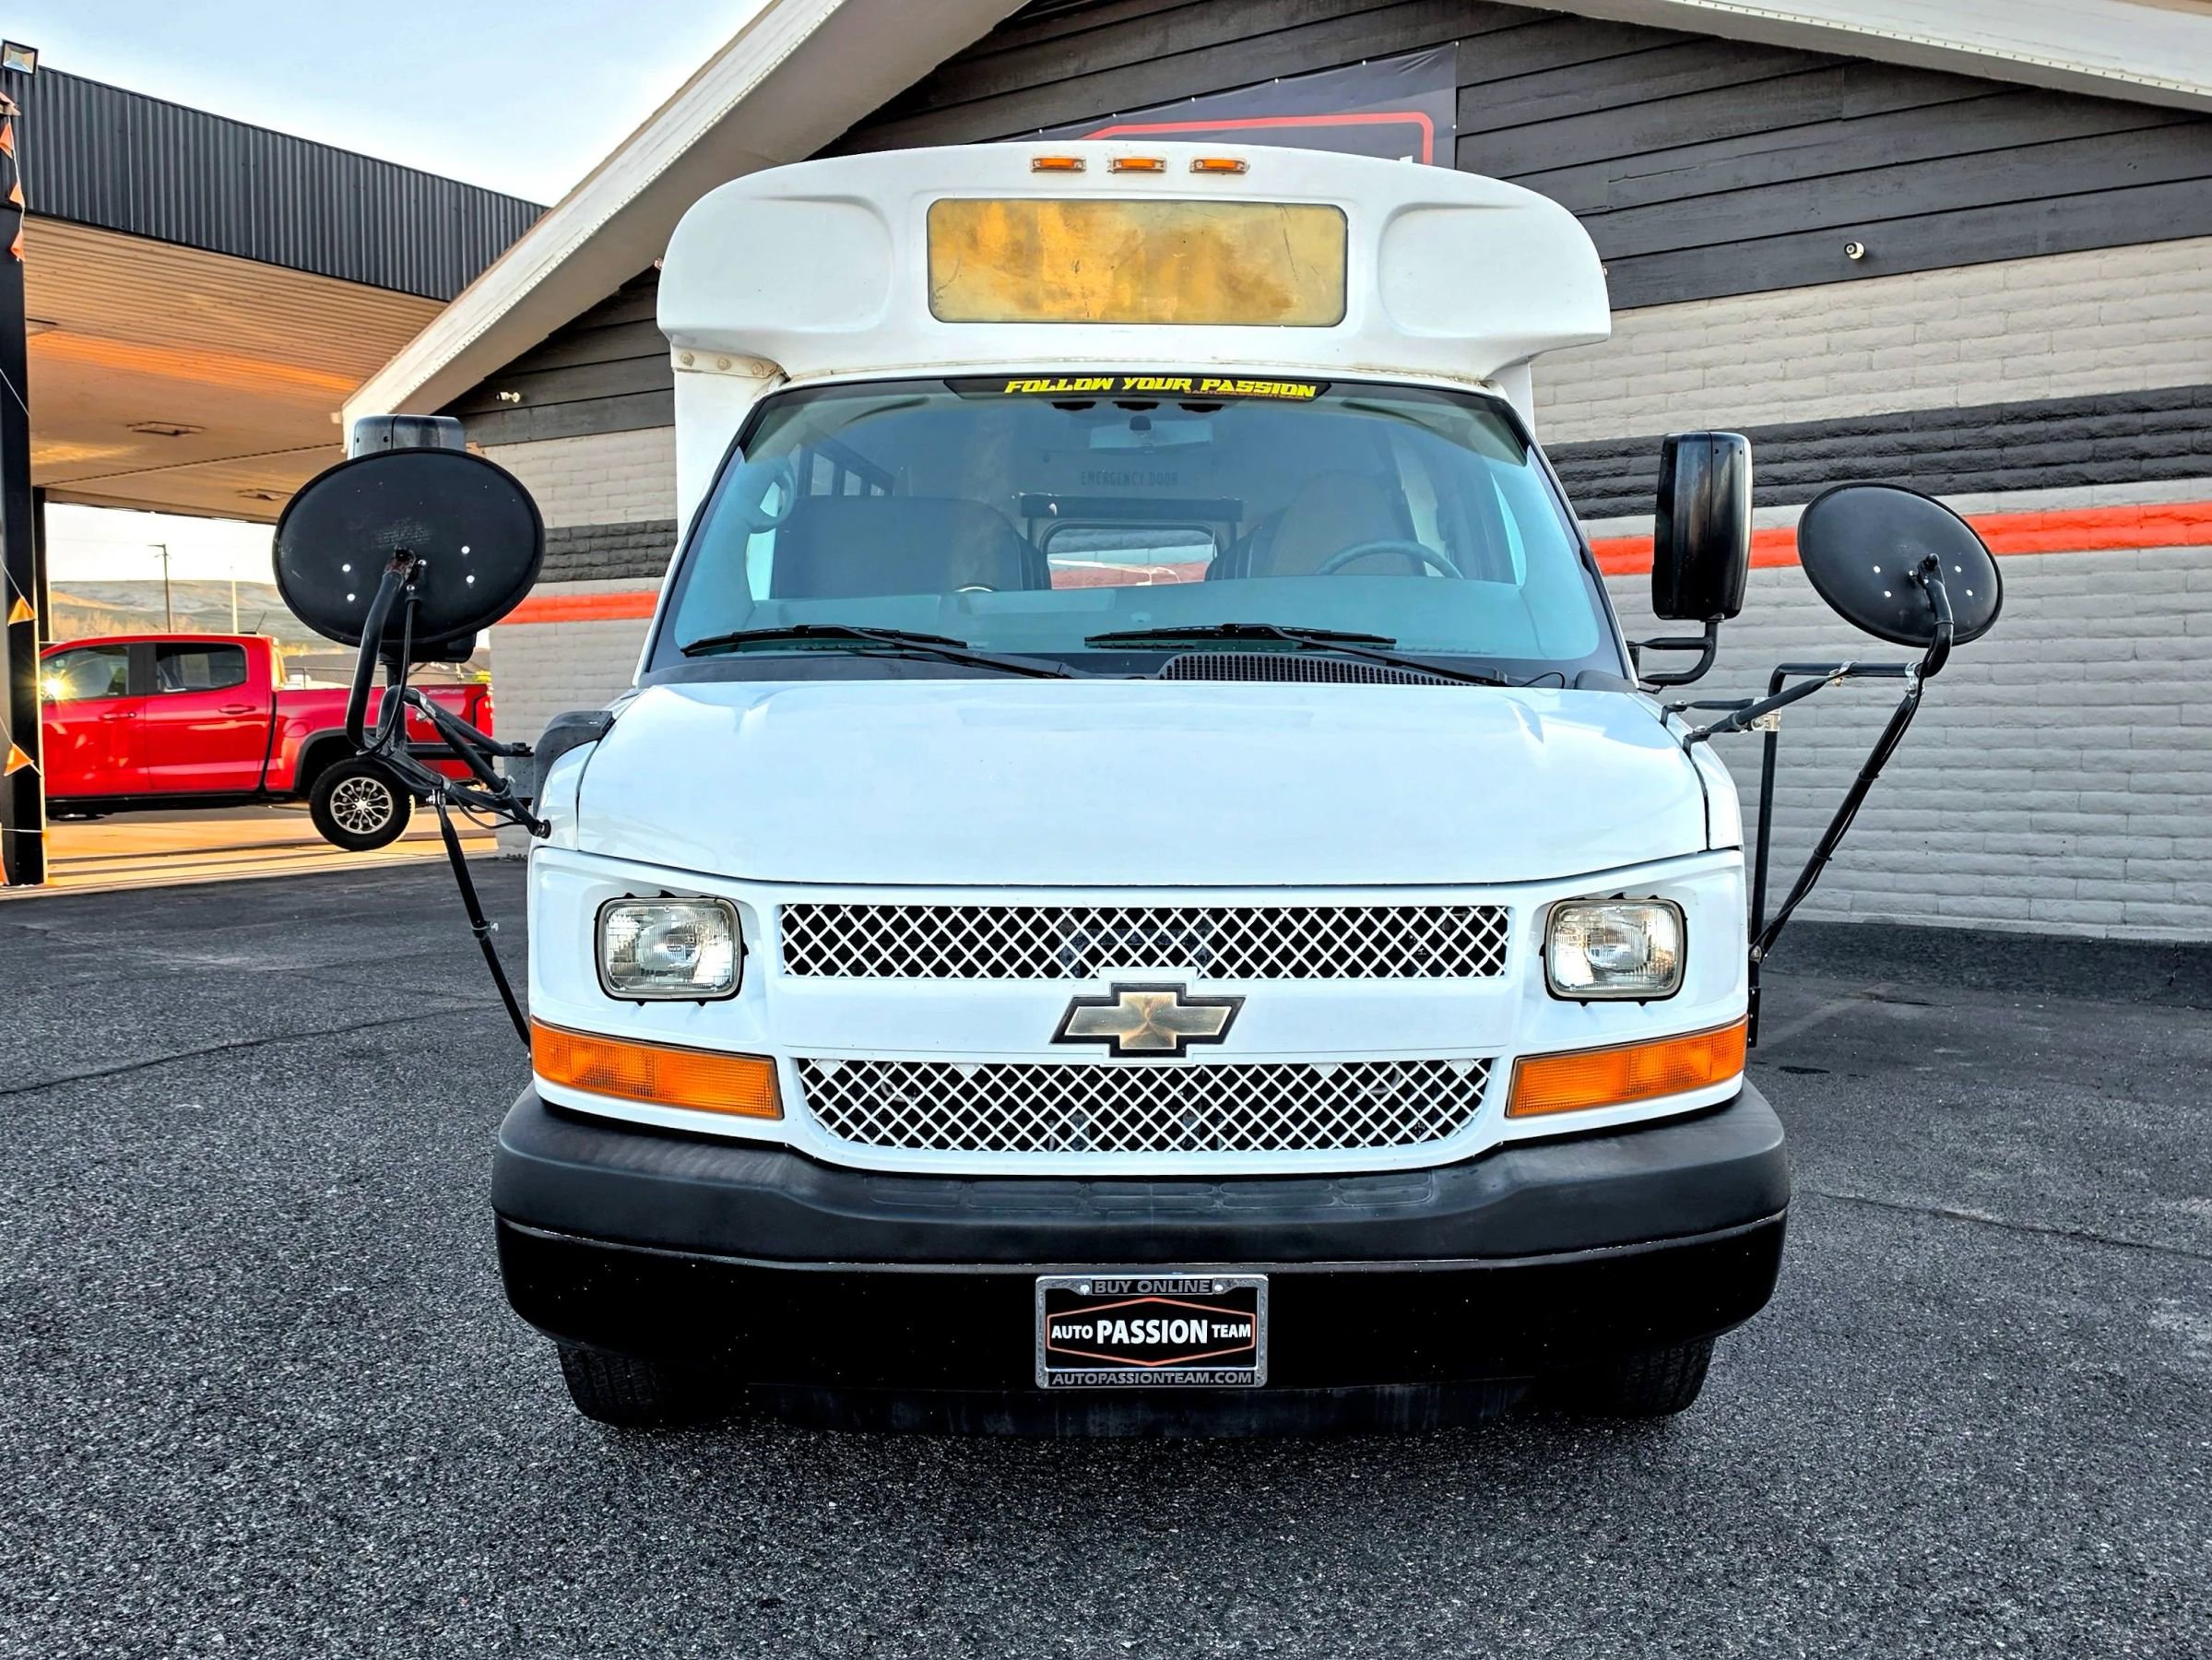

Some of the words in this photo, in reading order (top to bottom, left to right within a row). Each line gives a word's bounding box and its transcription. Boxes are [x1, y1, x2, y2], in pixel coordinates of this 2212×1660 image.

[1004, 378, 1115, 393] FOLLOW
[1121, 377, 1192, 390] YOUR
[1201, 379, 1316, 397] PASSION
[1081, 471, 1145, 486] EMERGENCY
[1149, 471, 1179, 486] DOOR
[1094, 1281, 1131, 1293] BUY
[1137, 1280, 1211, 1293] ONLINE
[1051, 1325, 1094, 1339] AUTO
[1097, 1320, 1208, 1344] PASSION
[1212, 1324, 1251, 1338] TEAM
[1052, 1371, 1252, 1385] AUTOPASSIONTEAM.COM
